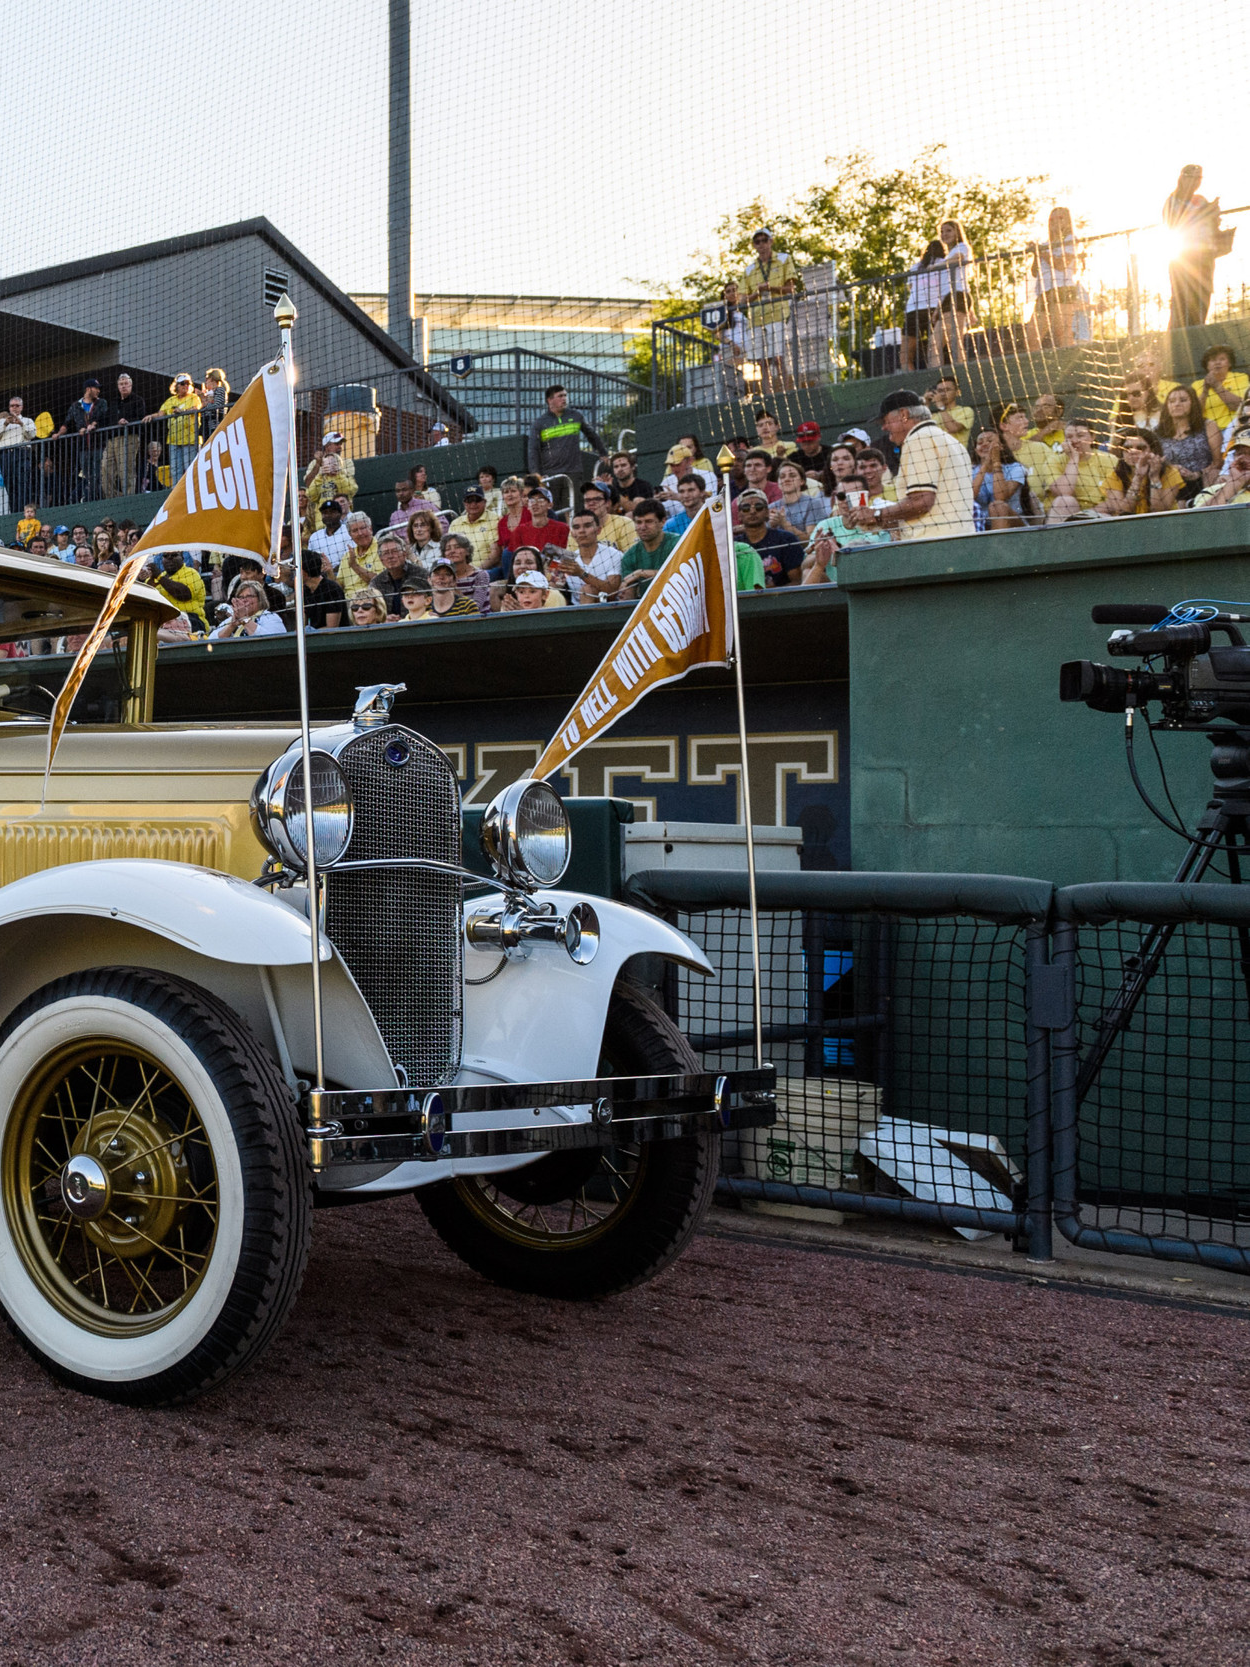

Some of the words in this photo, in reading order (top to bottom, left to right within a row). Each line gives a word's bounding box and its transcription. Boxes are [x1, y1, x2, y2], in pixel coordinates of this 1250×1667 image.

[705, 310, 720, 324] 10
[185, 416, 259, 514] TECH
[560, 718, 581, 751] TO
[579, 677, 619, 729] HELL
[611, 620, 664, 691] WITH
